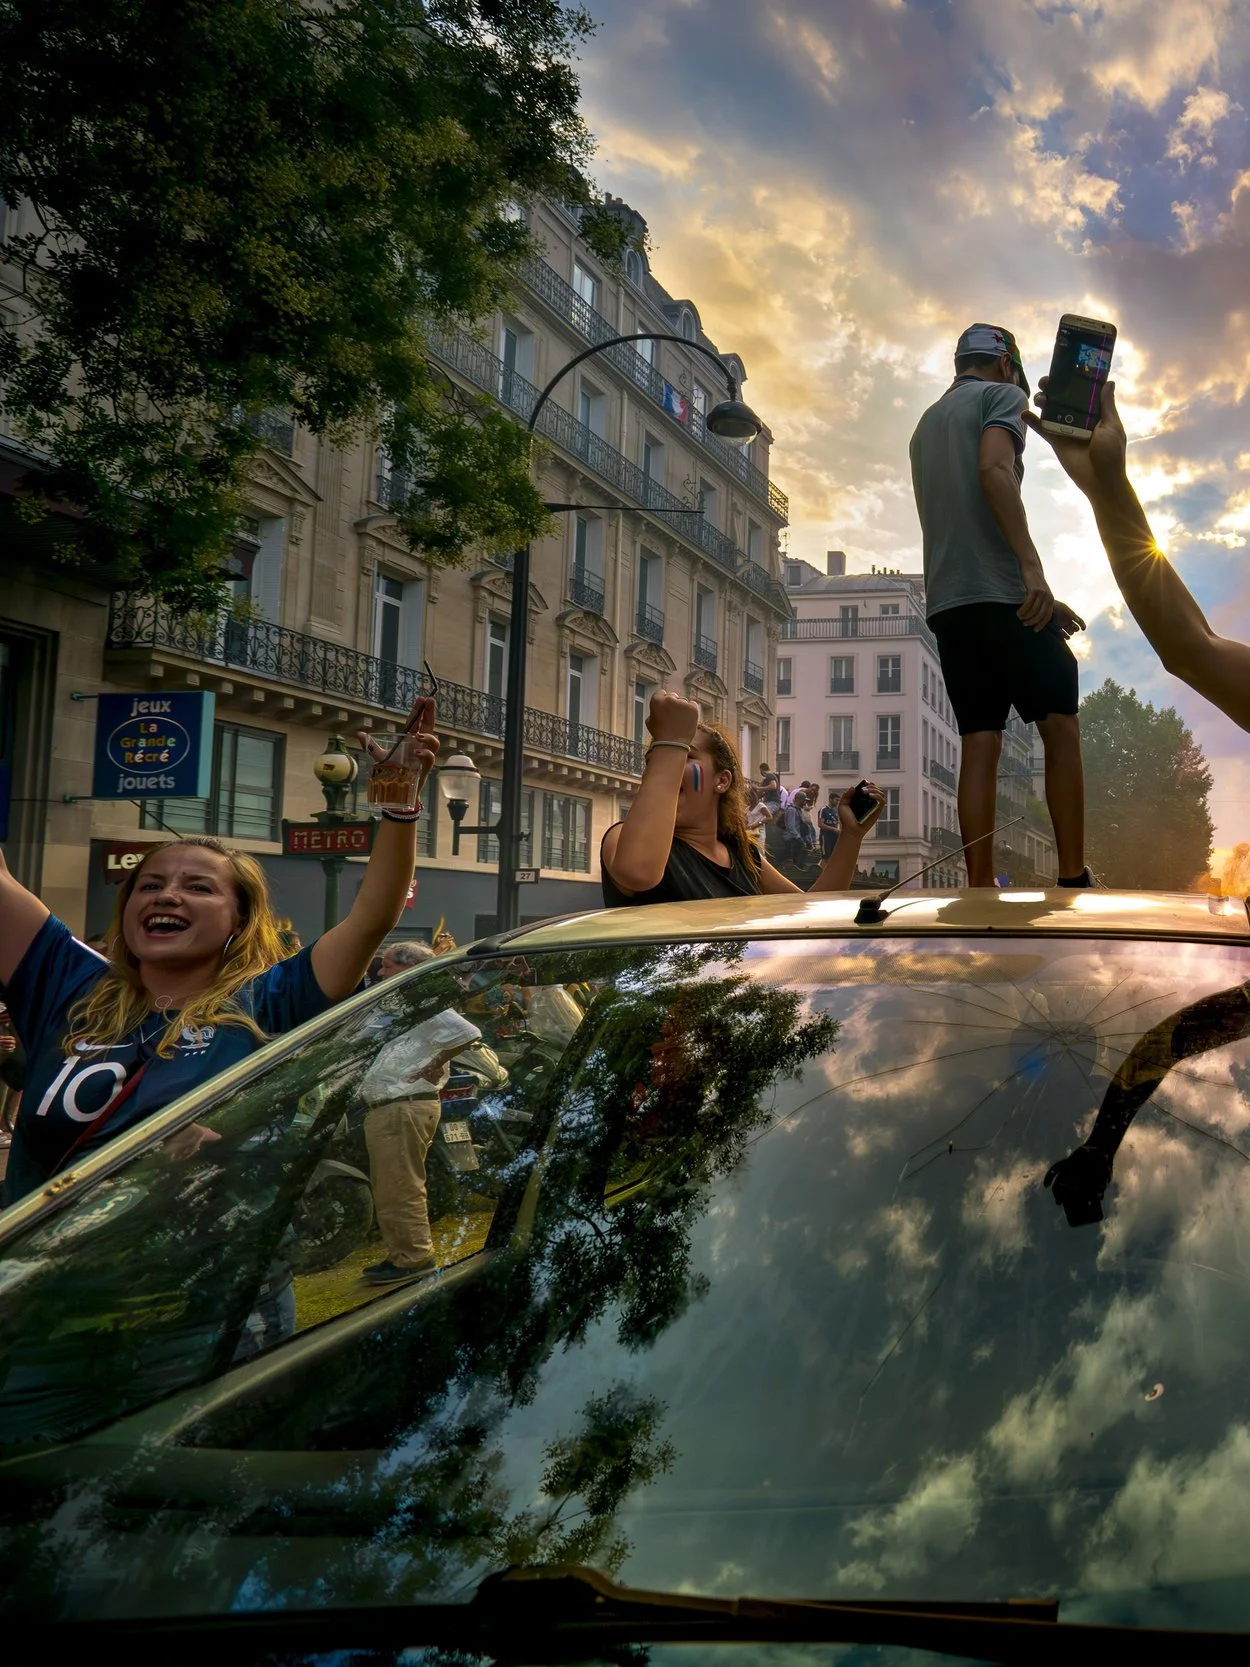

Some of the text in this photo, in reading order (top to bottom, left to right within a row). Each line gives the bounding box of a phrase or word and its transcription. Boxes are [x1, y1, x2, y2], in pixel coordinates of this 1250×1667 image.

[130, 698, 172, 717] jeux
[140, 723, 158, 733] La
[120, 736, 177, 748] Grande
[124, 749, 170, 763] Récré
[117, 774, 176, 793] jouets
[293, 830, 365, 849] METRO
[520, 872, 531, 880] 27
[36, 1055, 127, 1122] 10
